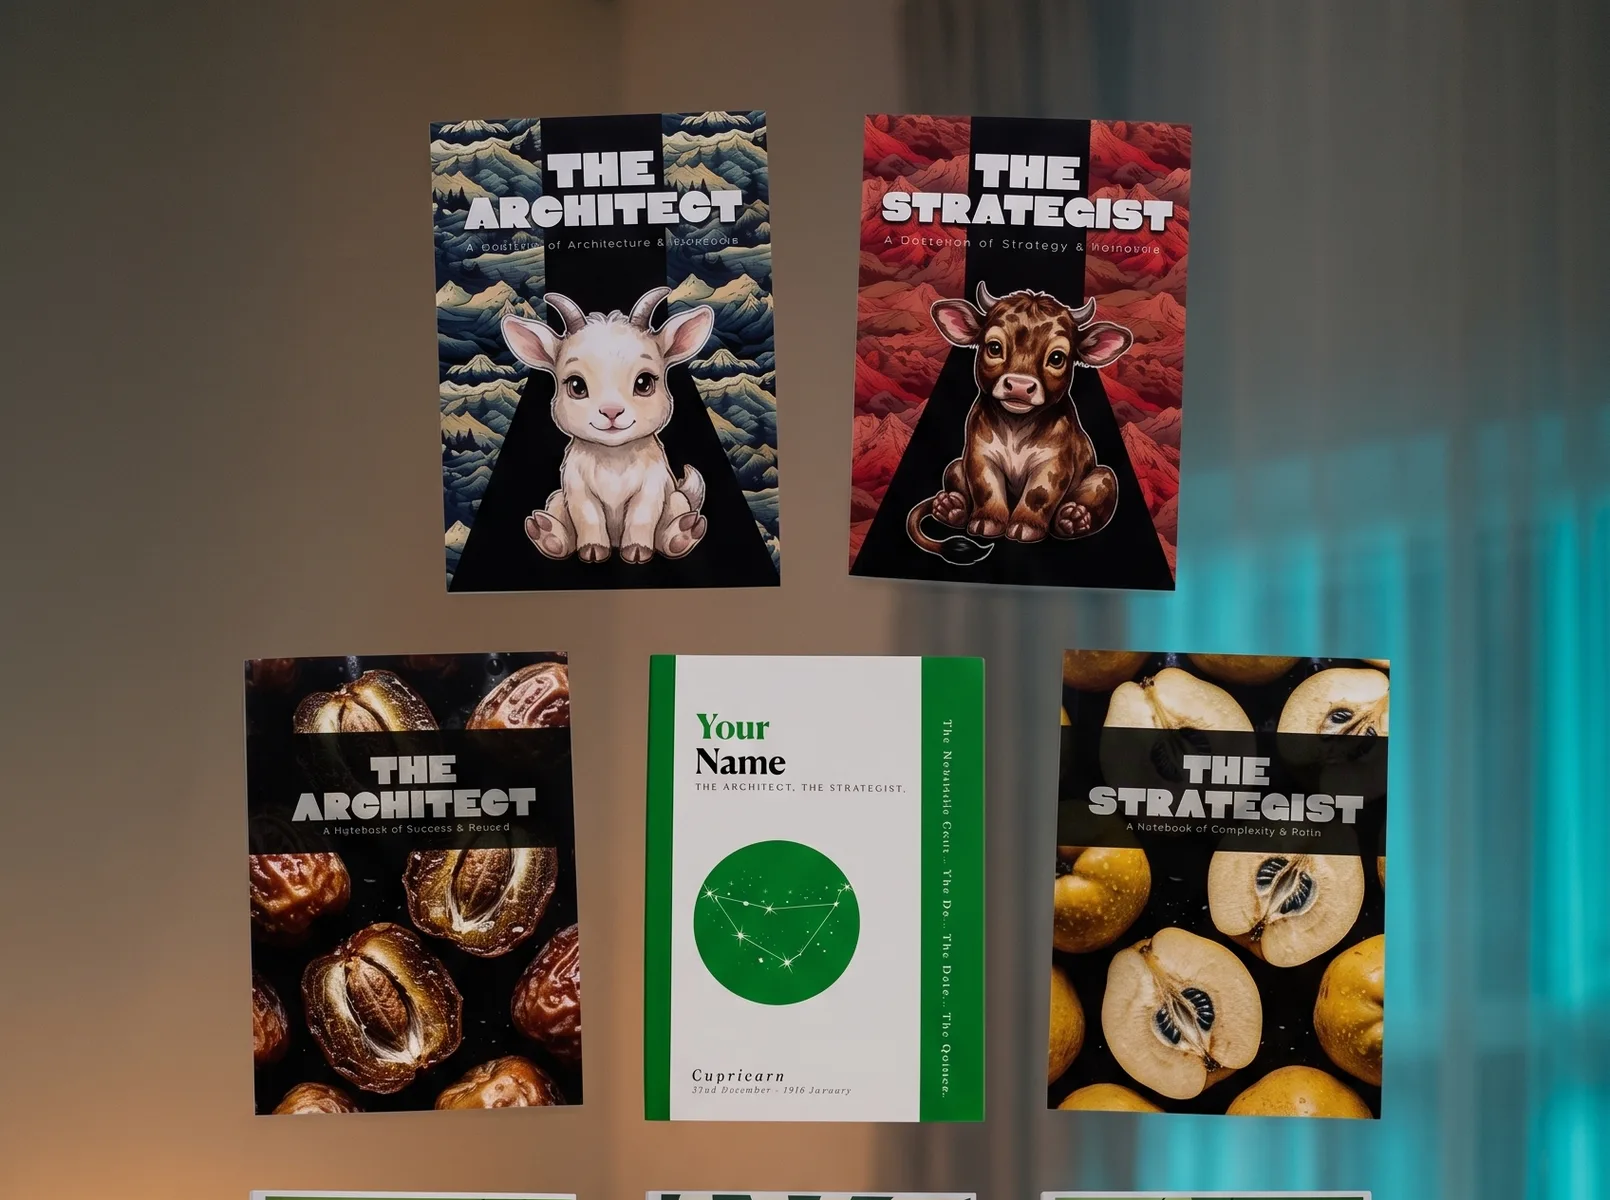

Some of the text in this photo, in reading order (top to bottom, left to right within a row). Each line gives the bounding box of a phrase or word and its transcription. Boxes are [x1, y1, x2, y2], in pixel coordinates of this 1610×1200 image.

[546, 150, 656, 189] THE
[974, 153, 1081, 191] THE
[463, 189, 744, 231] ARCHITECT
[881, 191, 1174, 232] STRATEGIST
[547, 240, 561, 251] of
[567, 237, 651, 250] Architecture
[656, 237, 665, 247] &
[883, 235, 894, 245] A
[978, 238, 994, 249] of
[1001, 239, 1068, 253] Strategy
[1075, 242, 1084, 252] &
[696, 712, 770, 740] Your
[369, 754, 457, 785] THE
[695, 747, 787, 776] Name
[1182, 754, 1271, 786] THE
[695, 782, 718, 792] THE
[801, 783, 824, 792] THE
[291, 787, 537, 822] ARCHITECT
[1087, 786, 1364, 824] STRATEGIST
[322, 827, 331, 835] A
[391, 824, 403, 834] of
[406, 824, 453, 834] Success
[456, 823, 465, 833] &
[1126, 822, 1134, 831] A
[1195, 824, 1208, 833] of
[1211, 825, 1276, 838] Complexity
[1279, 827, 1288, 836] &
